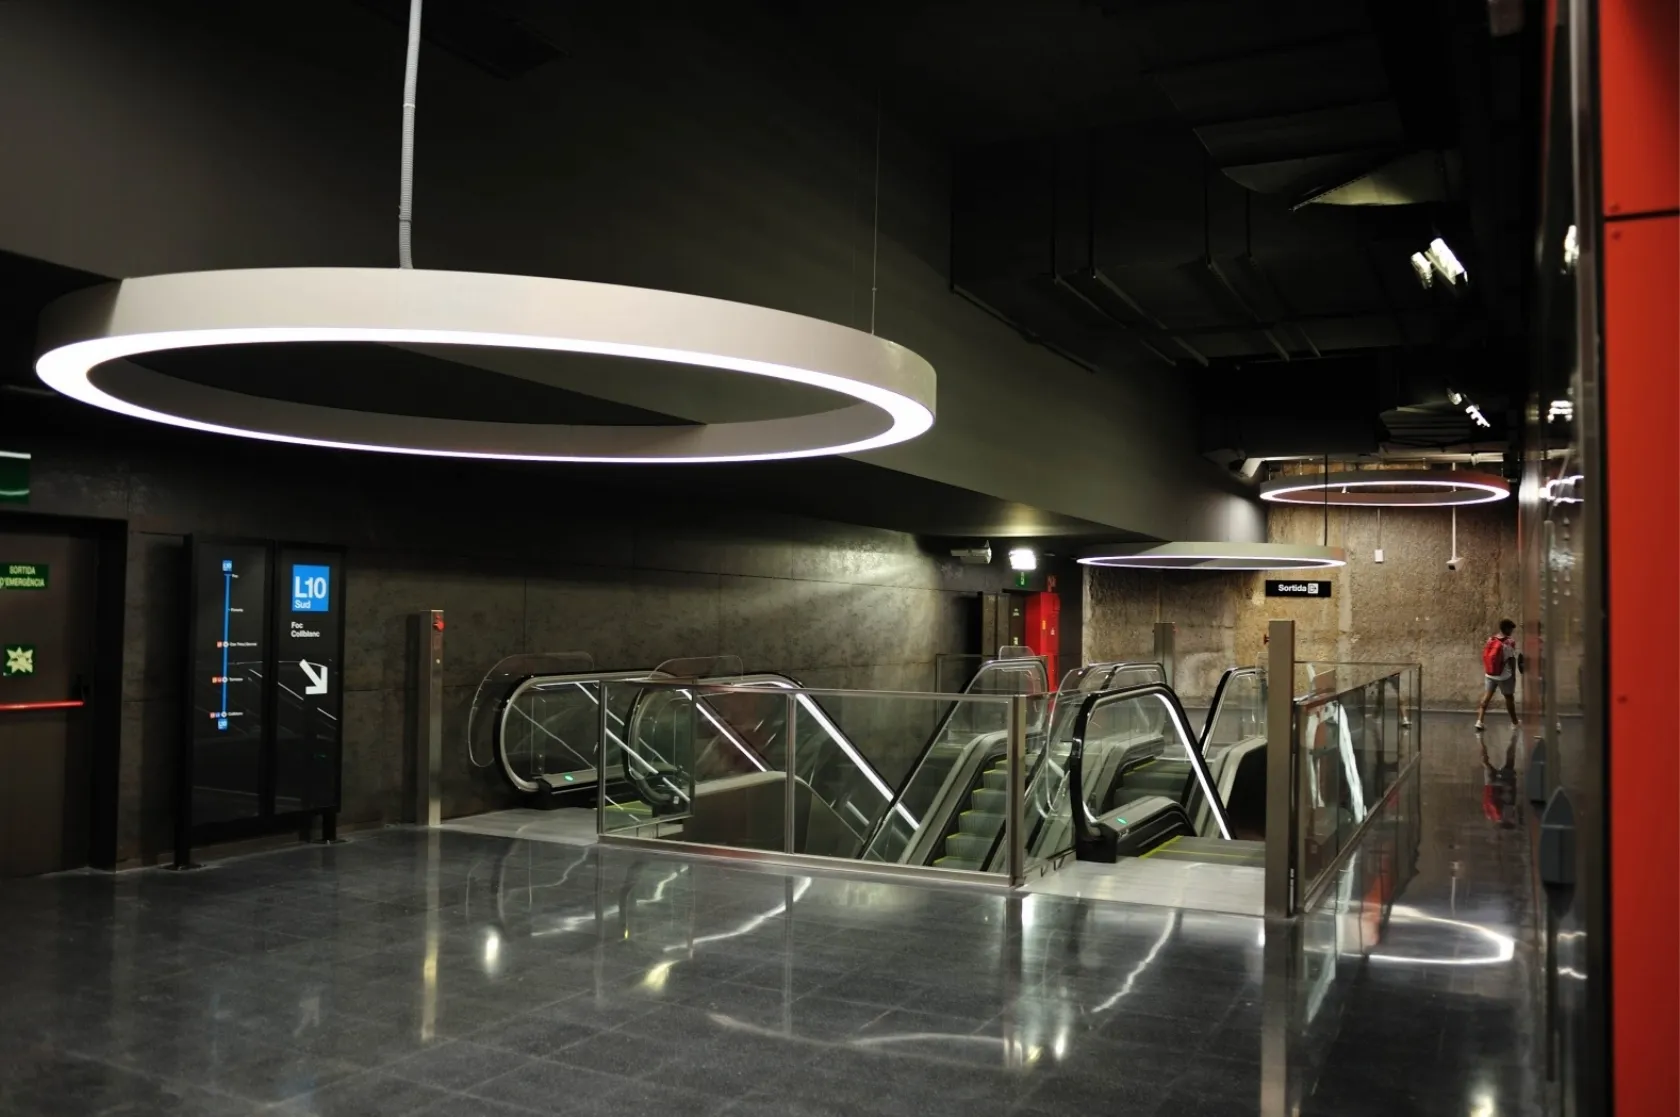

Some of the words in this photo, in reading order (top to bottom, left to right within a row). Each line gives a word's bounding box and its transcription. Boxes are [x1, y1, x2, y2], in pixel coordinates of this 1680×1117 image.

[9, 565, 36, 575] SORTIDA
[295, 576, 327, 599] L10
[1278, 584, 1307, 592] Sortida
[295, 600, 311, 609] Sud
[291, 621, 304, 629] Foc
[291, 630, 320, 638] Collblanc
